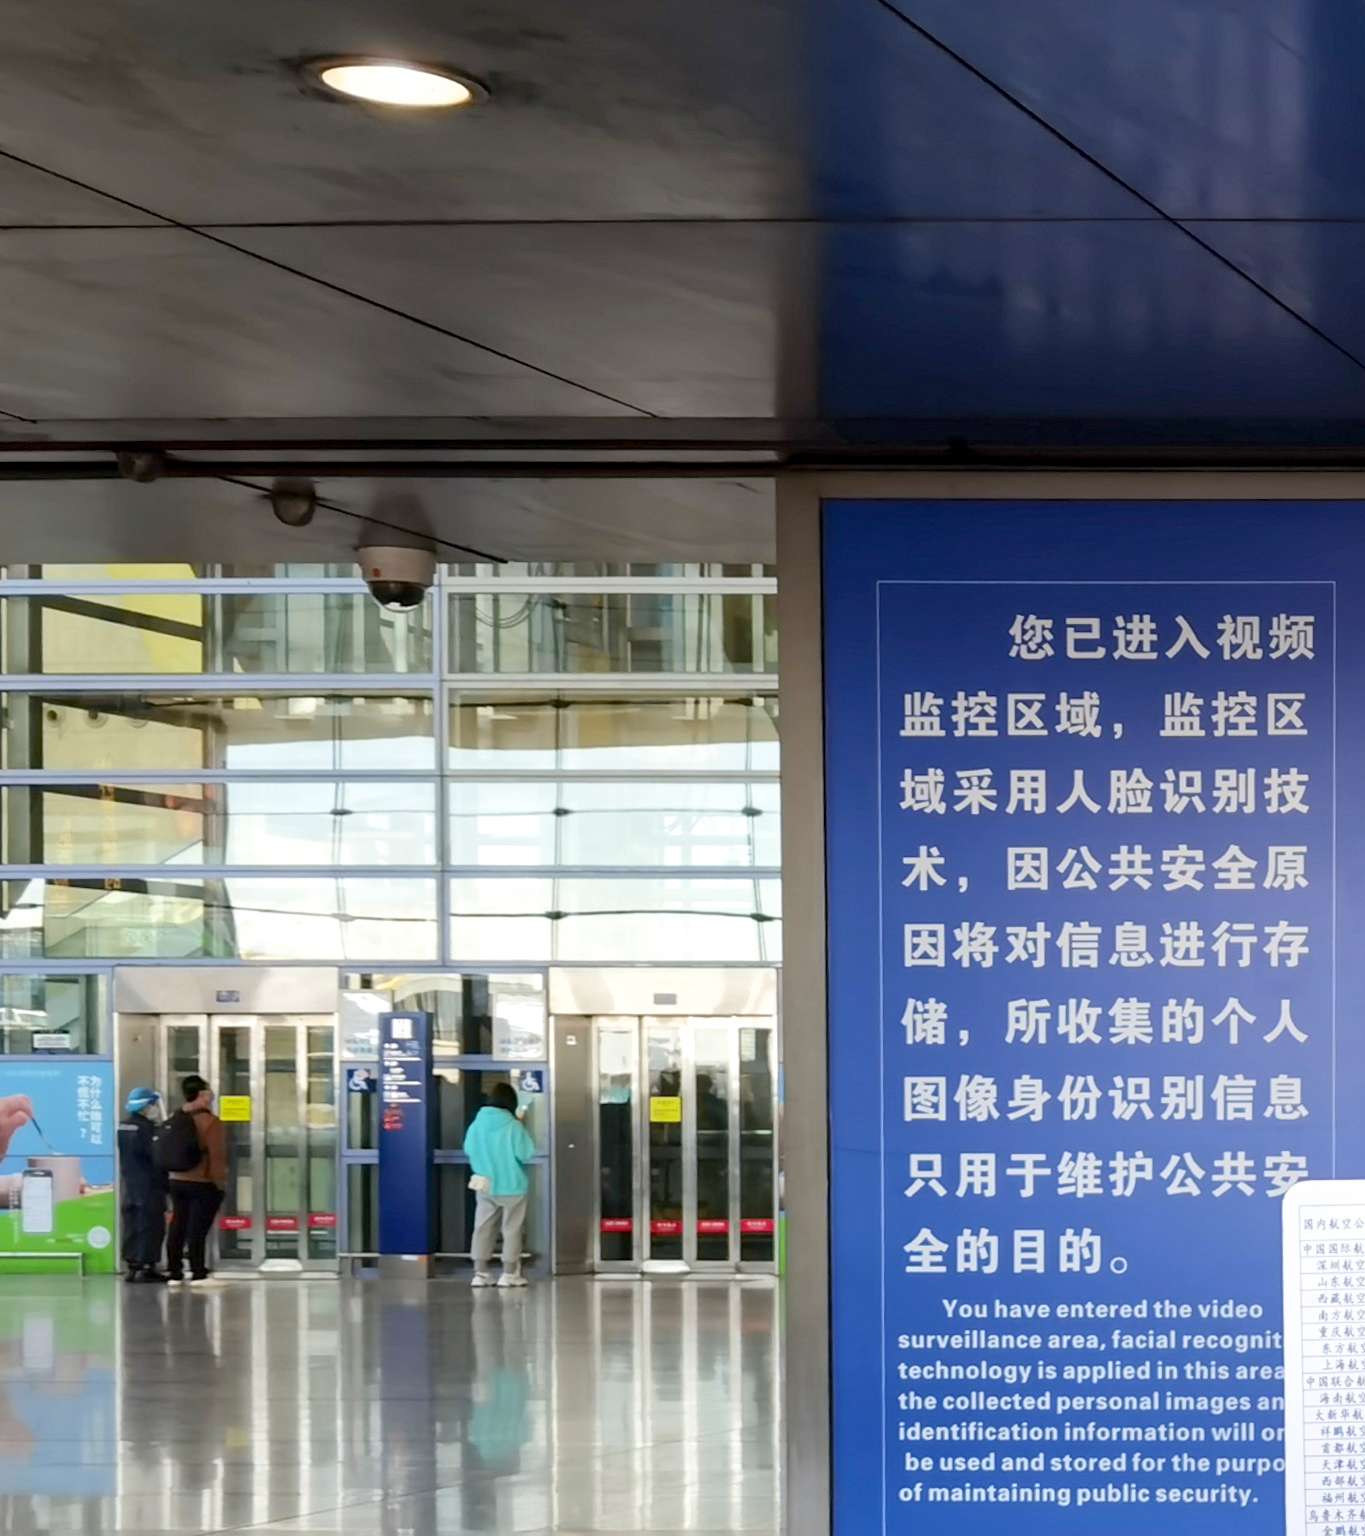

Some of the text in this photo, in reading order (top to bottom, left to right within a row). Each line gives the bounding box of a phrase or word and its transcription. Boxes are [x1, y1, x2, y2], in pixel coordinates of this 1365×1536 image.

[1008, 613, 1315, 661] 您已进入视频
[899, 690, 1309, 740] 监控区域，监控区
[899, 767, 1310, 815] 域采用人脸识别技
[901, 843, 1310, 893] 术，因公共安全原
[904, 920, 1310, 968] 因将对信息进行存
[901, 996, 1309, 1046] 储，所收集的个人
[904, 1073, 1309, 1122] 图像身份识别信息
[903, 1150, 1309, 1198] 只用于维护公共安
[903, 1227, 1128, 1274] 全的目的。
[942, 1299, 1264, 1319] You have entered the video
[898, 1329, 1282, 1354] surveillance area, facial recognit
[899, 1421, 1285, 1442] identification information will on
[899, 1482, 1259, 1507] of maintaining public security.
